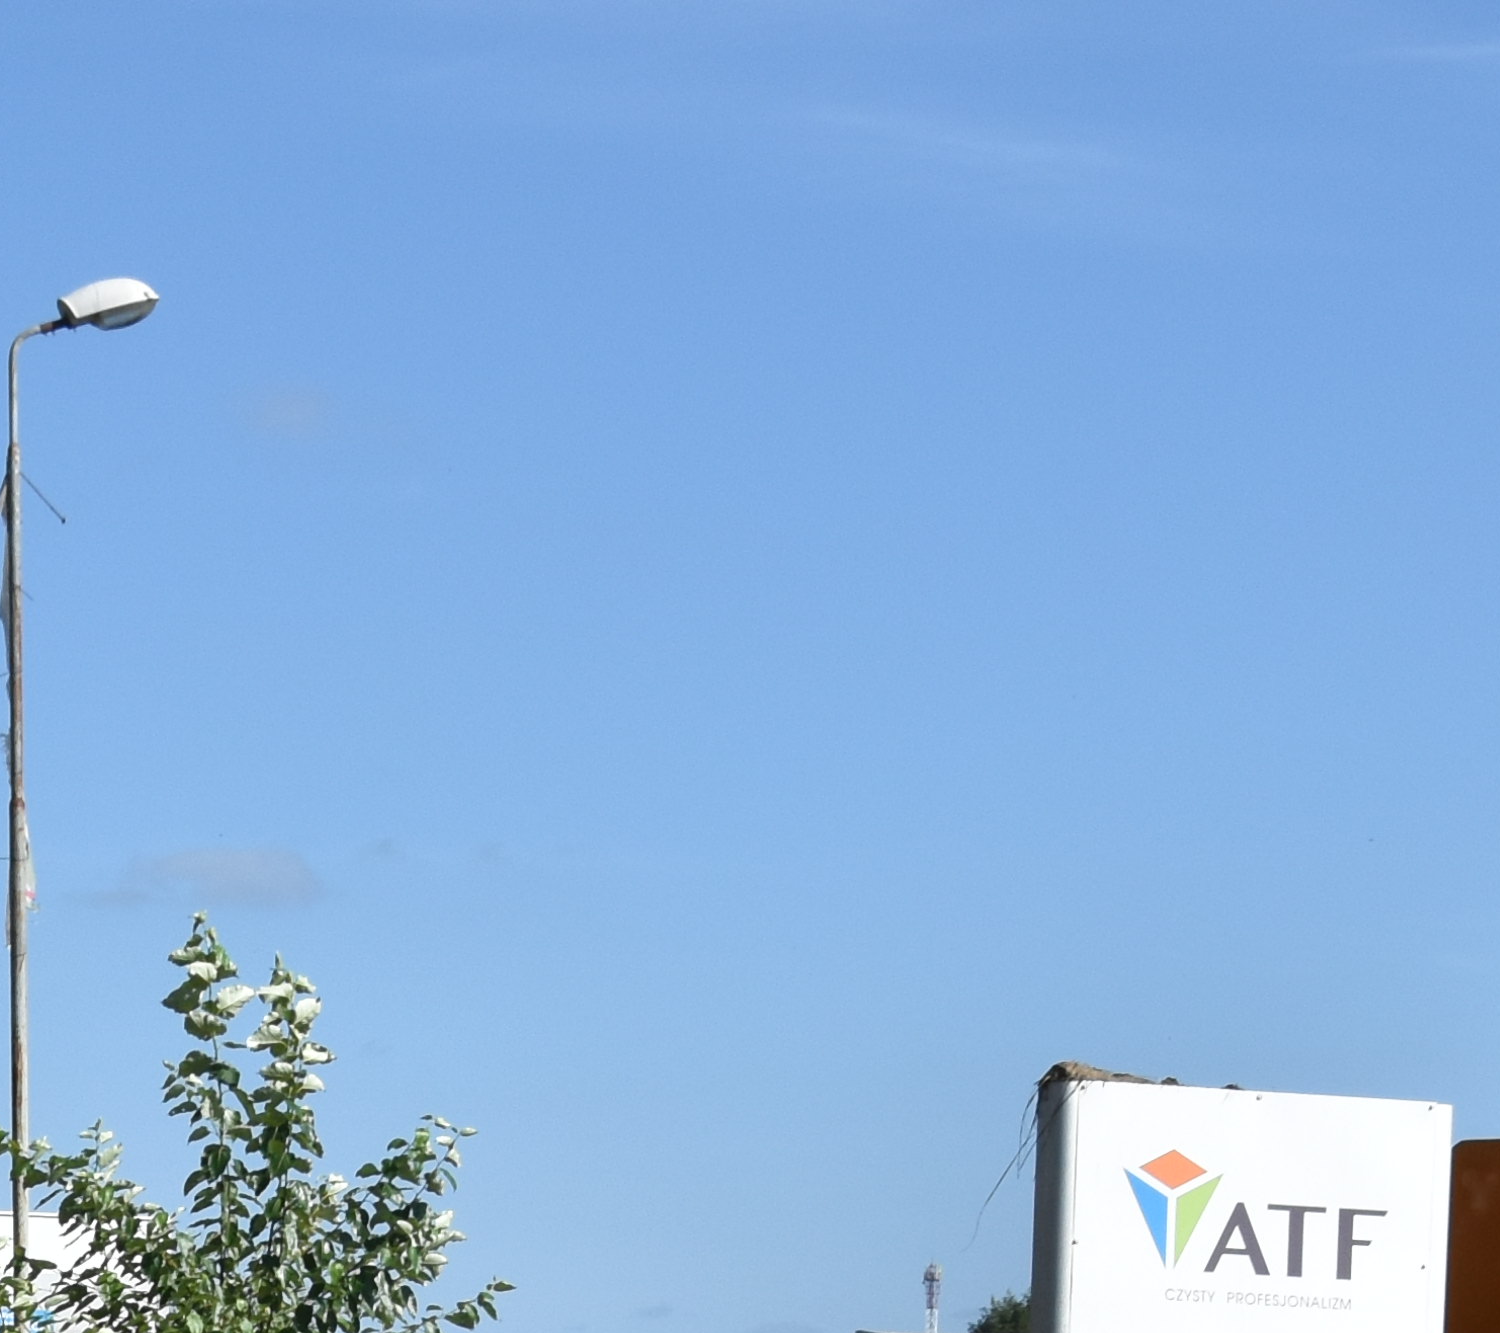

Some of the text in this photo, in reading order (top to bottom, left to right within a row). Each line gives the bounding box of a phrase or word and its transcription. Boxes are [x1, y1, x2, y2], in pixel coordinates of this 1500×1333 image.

[1203, 1202, 1388, 1280] ATF
[1164, 1288, 1352, 1311] CZYSTY PROFESJONALIZM
